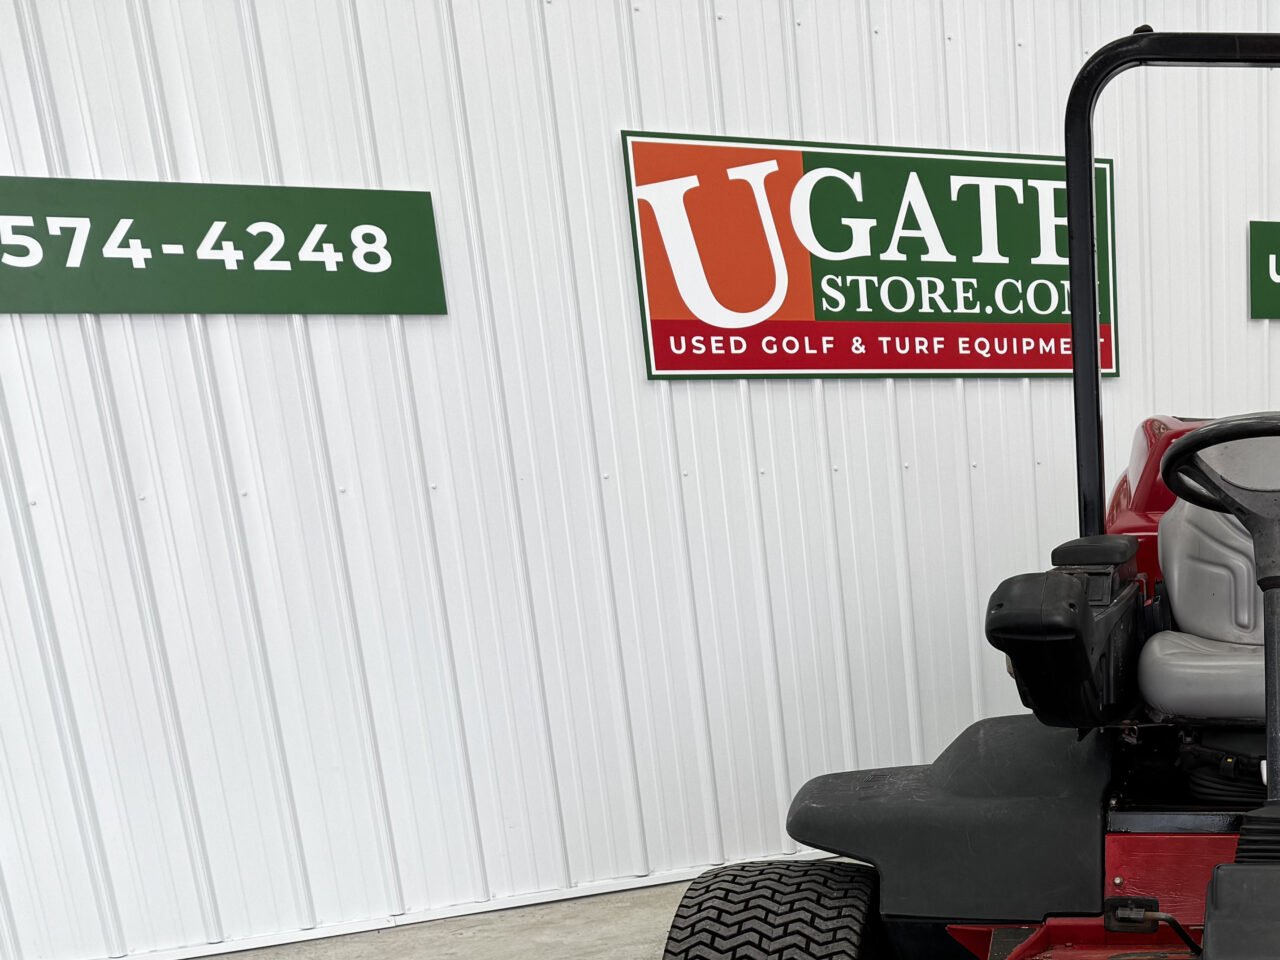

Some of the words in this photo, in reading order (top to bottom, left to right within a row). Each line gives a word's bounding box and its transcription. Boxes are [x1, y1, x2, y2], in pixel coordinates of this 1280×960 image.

[0, 214, 392, 273] 574-4248
[669, 335, 748, 355] USED
[761, 335, 835, 355] GOLF
[850, 336, 866, 354] &
[877, 336, 946, 354] TURF
[958, 336, 1105, 358] EQUIPME
